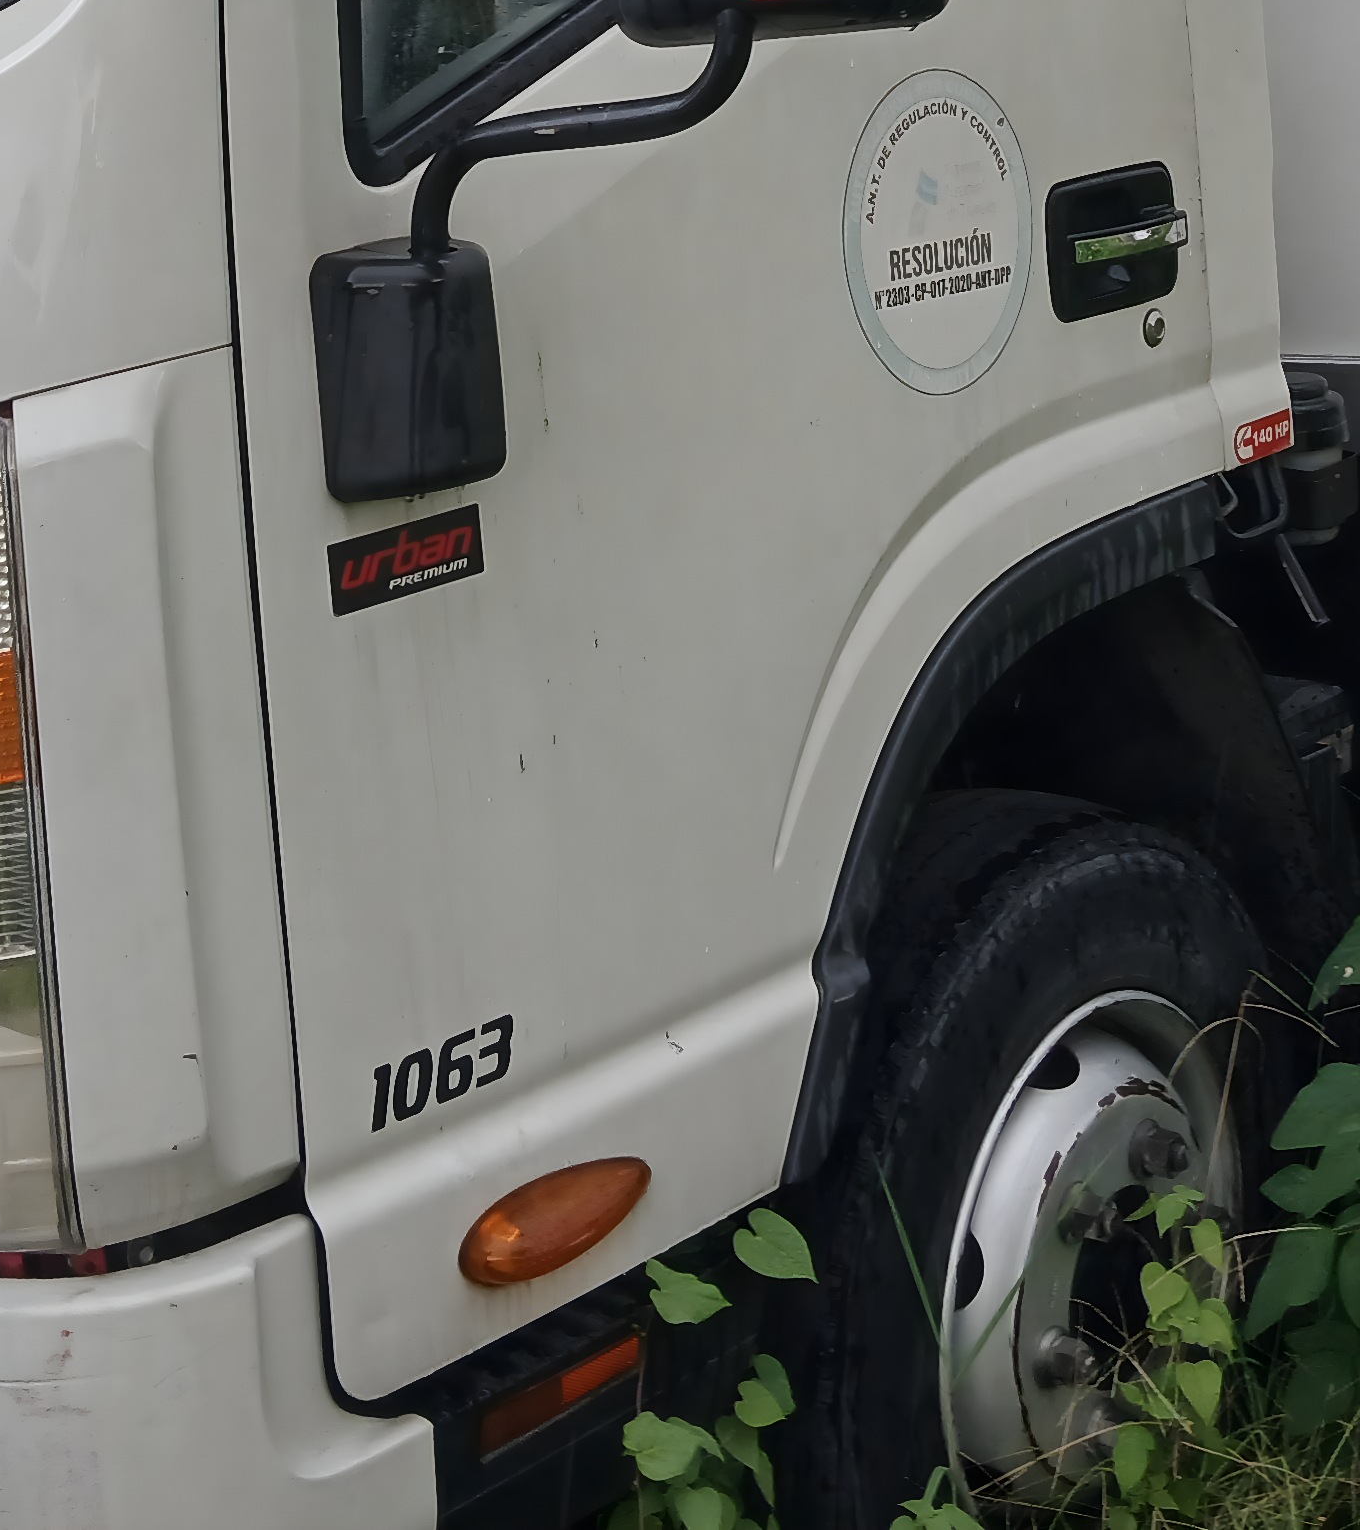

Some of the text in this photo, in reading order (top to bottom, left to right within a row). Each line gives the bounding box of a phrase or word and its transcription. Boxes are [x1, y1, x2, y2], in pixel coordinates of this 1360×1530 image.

[889, 98, 957, 146] REGULACIÓN
[960, 107, 969, 121] Y
[969, 115, 1008, 181] CONTROL
[889, 227, 992, 282] RESOLUCIÓN
[1253, 426, 1273, 447] 140
[1274, 420, 1289, 440] HP
[341, 529, 473, 591] urban
[389, 557, 468, 591] PREMIUM
[371, 1013, 514, 1133] 1063
